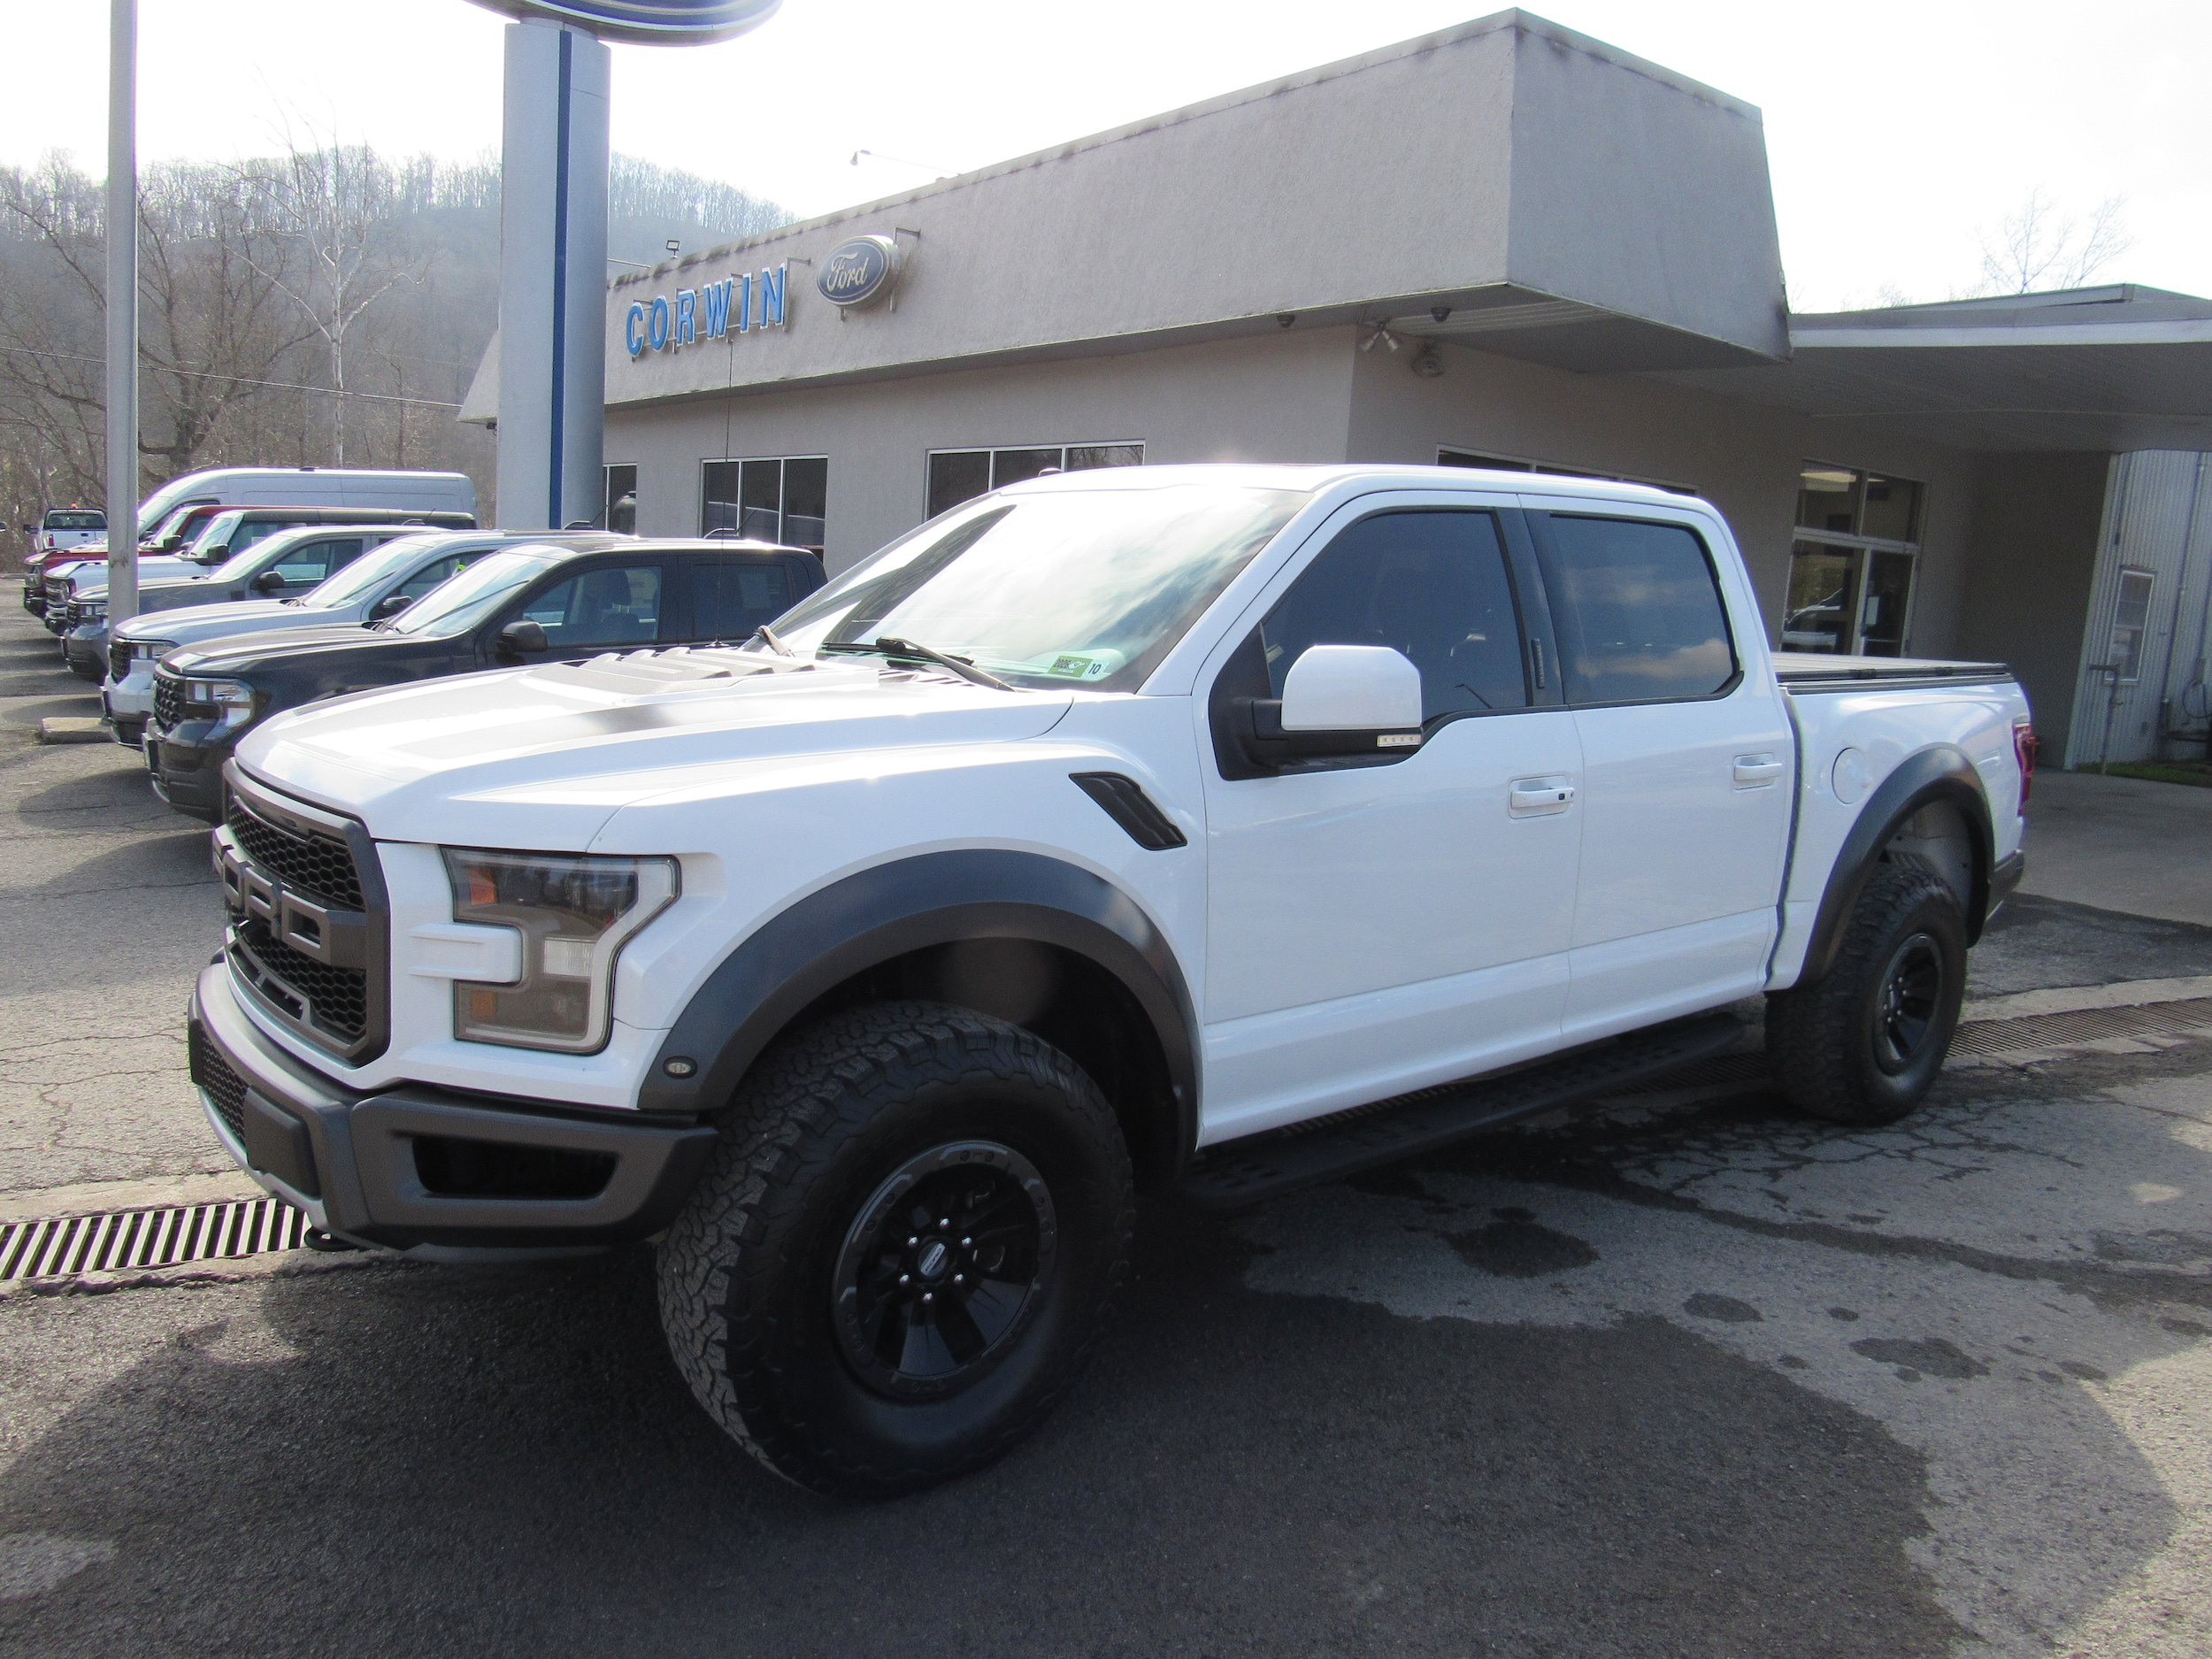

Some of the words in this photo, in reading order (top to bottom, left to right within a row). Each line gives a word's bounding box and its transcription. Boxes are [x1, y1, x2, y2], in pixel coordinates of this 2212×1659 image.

[826, 251, 870, 292] Ford
[626, 264, 787, 357] CORWIN
[1088, 664, 1102, 674] 10
